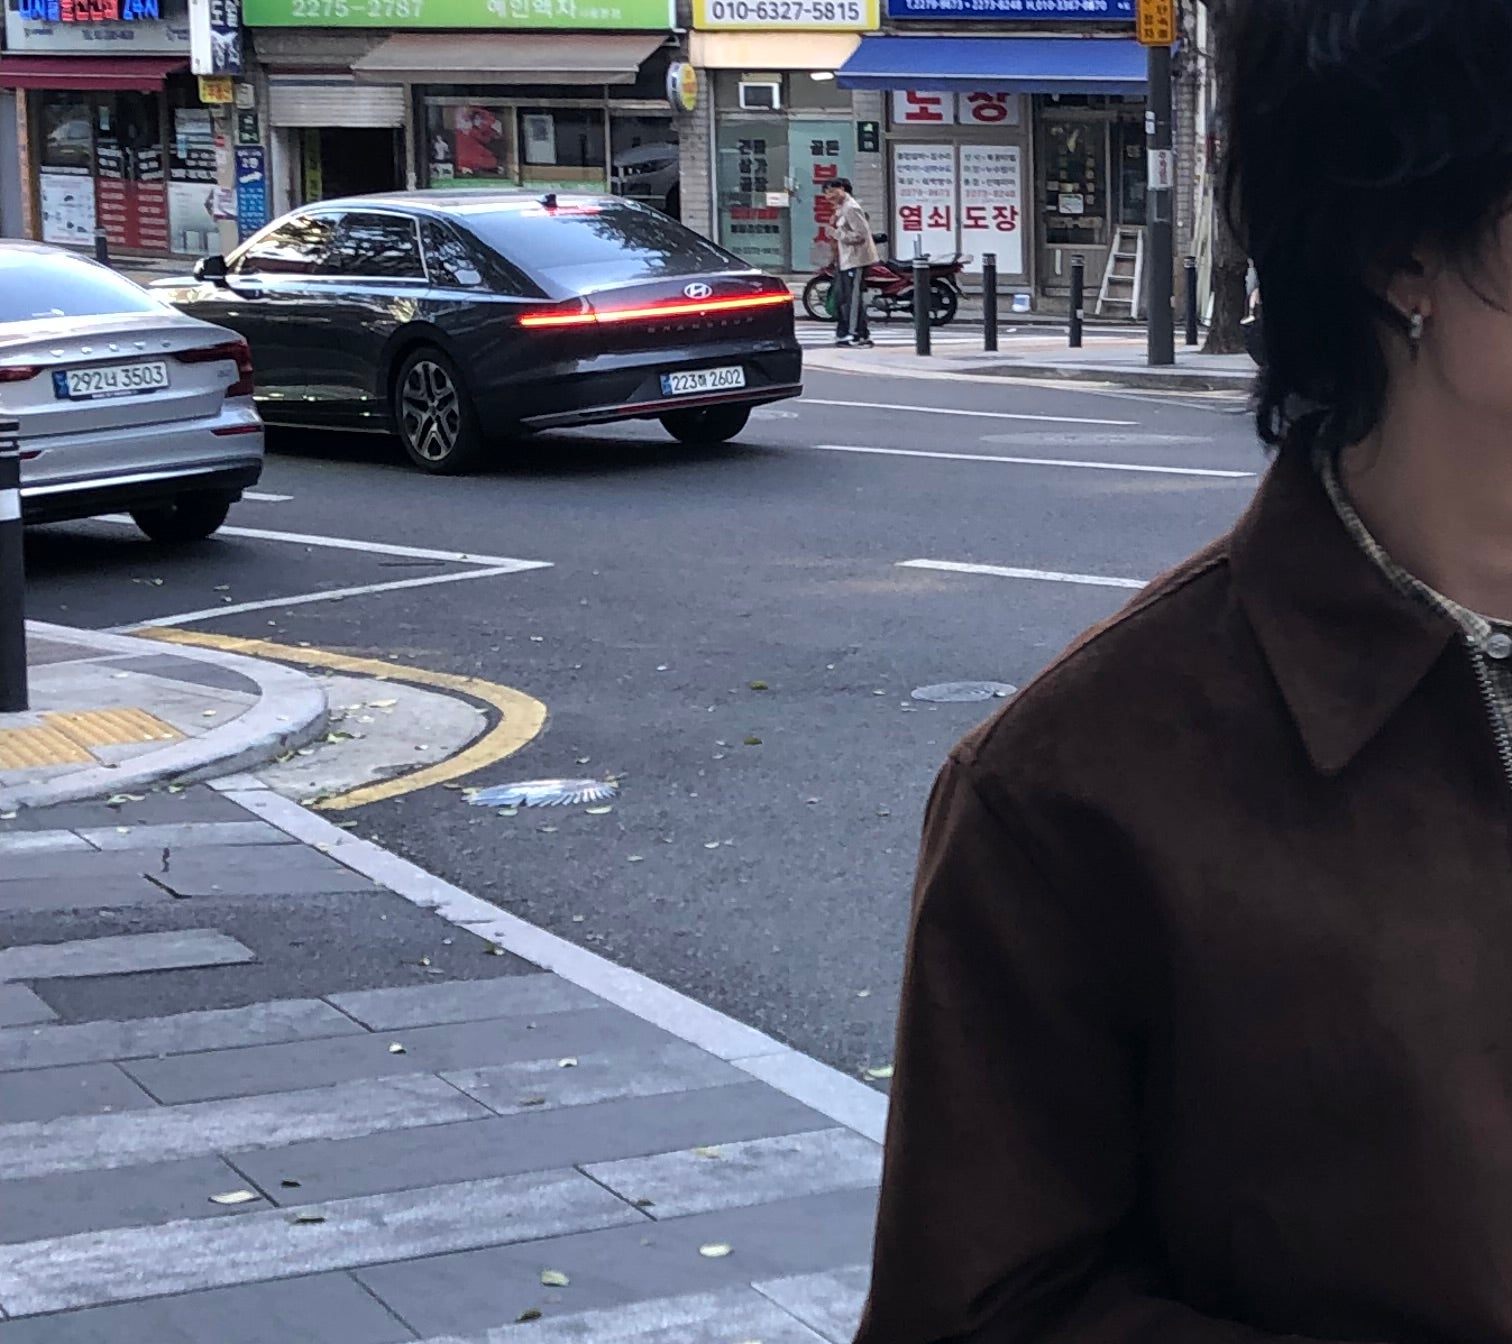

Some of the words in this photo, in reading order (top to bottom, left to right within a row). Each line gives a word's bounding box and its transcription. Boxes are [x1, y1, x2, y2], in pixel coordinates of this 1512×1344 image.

[712, 1, 860, 21] 010-6327-5815
[899, 205, 952, 232] 열쇠
[963, 205, 1019, 232] 도장
[121, 365, 164, 388] 3503
[710, 369, 743, 387] 2602
